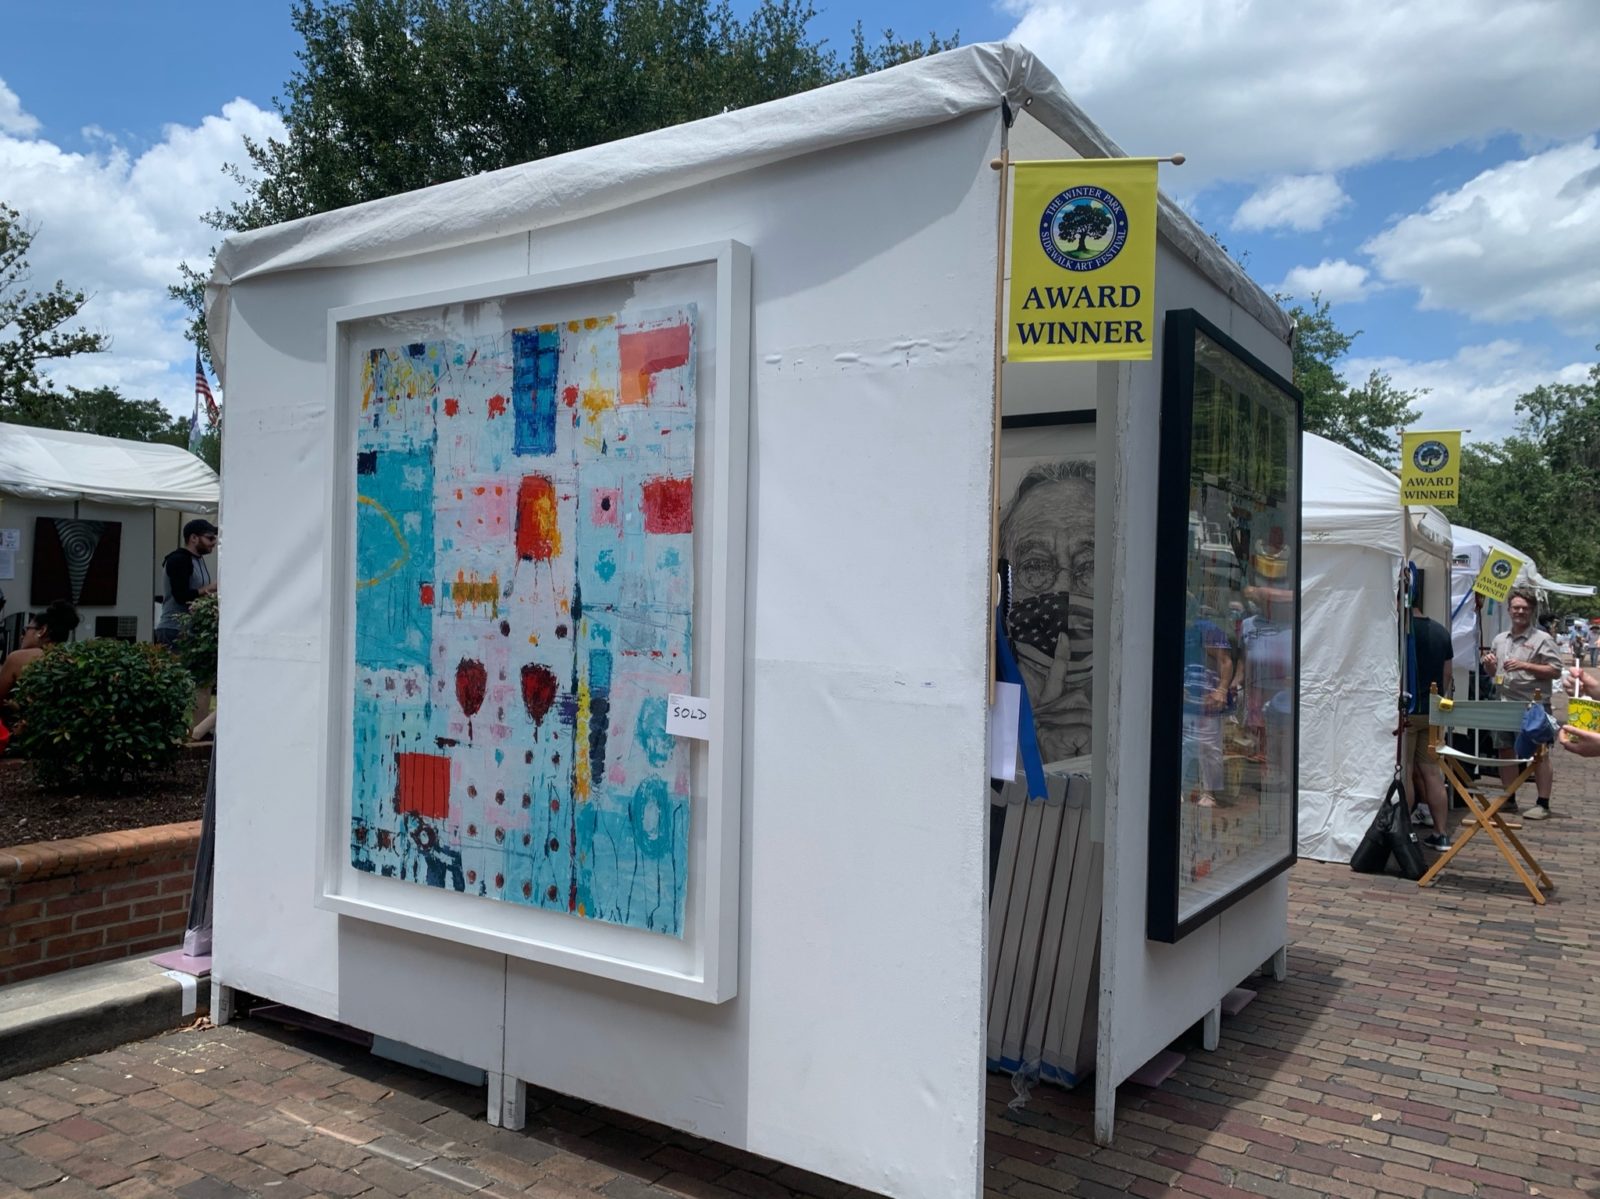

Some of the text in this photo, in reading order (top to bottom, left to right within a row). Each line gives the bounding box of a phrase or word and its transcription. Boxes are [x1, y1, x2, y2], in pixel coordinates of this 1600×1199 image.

[1046, 187, 1122, 216] THE WINTER PARK
[1041, 230, 1126, 271] SIDEWALK ART FESTIVAL
[1022, 285, 1141, 310] AWARD
[1016, 320, 1146, 345] WINNER
[1406, 477, 1454, 487] AWARD
[1404, 490, 1455, 500] WINNER
[1476, 582, 1505, 599] WINNER
[1481, 577, 1508, 591] AWARD
[673, 706, 707, 720] SOLD
